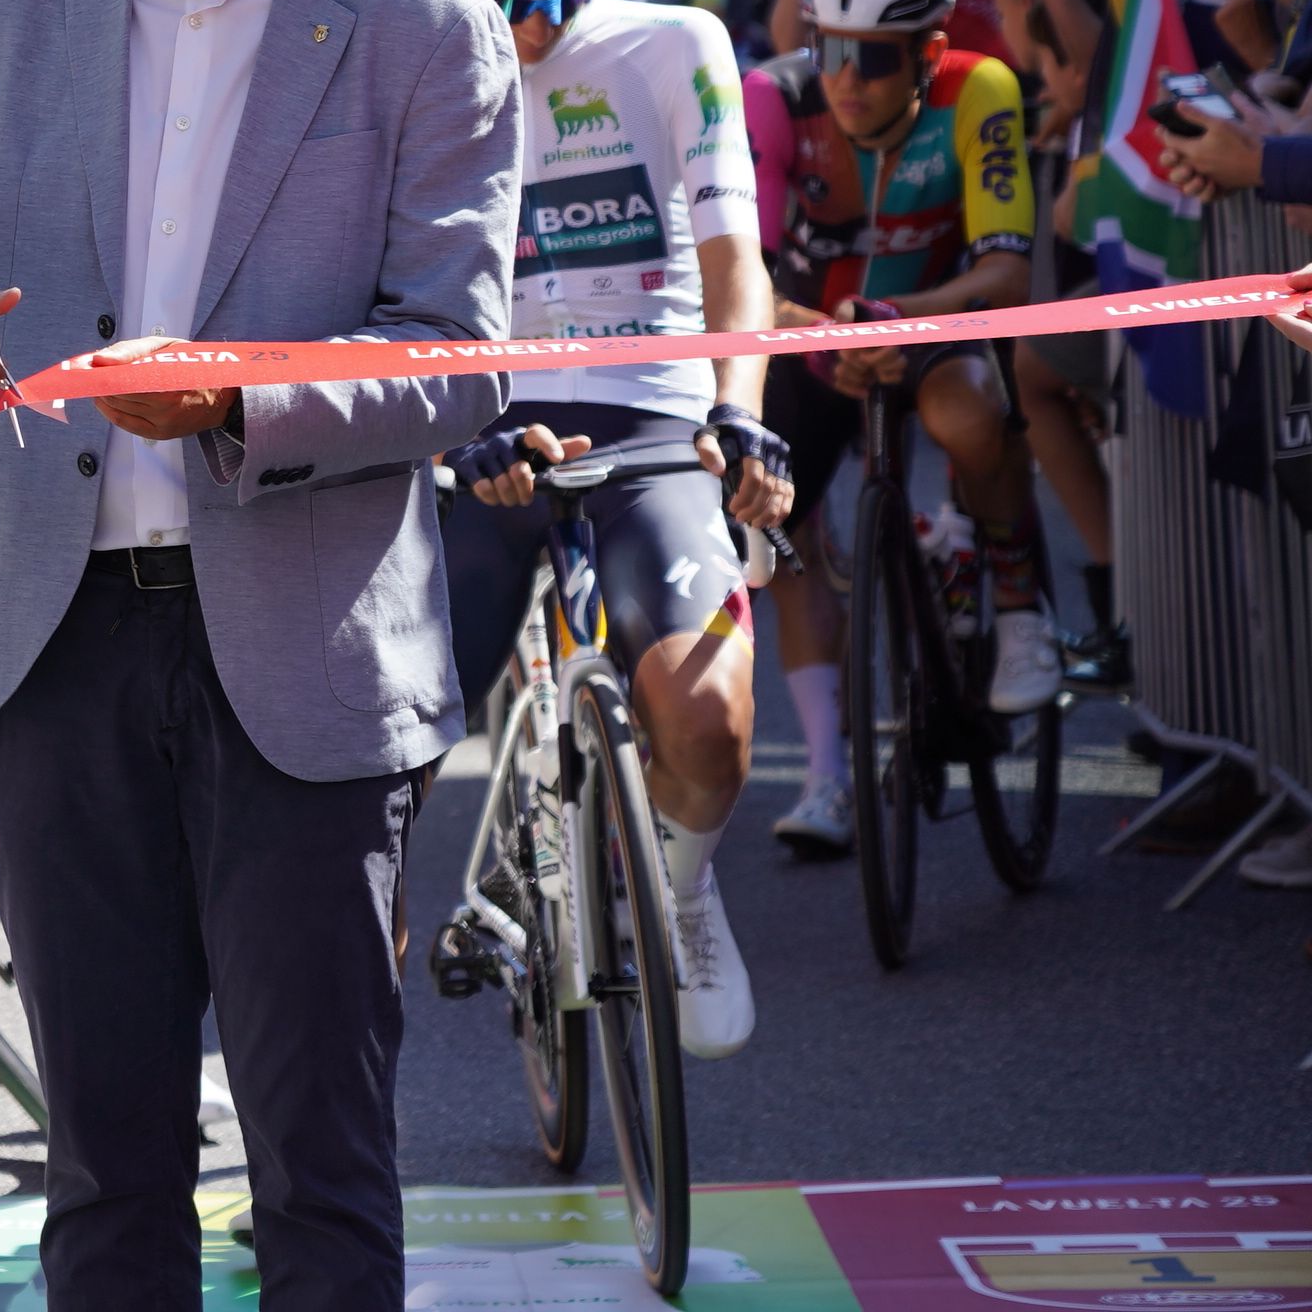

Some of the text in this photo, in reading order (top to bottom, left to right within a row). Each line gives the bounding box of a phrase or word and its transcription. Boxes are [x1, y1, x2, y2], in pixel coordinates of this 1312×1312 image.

[544, 140, 634, 166] plenitude
[536, 194, 654, 234] BORA
[543, 222, 656, 251] hansgrohe
[1104, 304, 1150, 316] LA
[756, 330, 796, 343] LA
[798, 322, 942, 339] VUELTA
[248, 350, 290, 363] 25
[406, 347, 454, 360] LA
[455, 342, 590, 356] VUELTA
[962, 1200, 1022, 1213] LA
[1026, 1196, 1210, 1212] VUELTA
[410, 1211, 589, 1224] VUELTA
